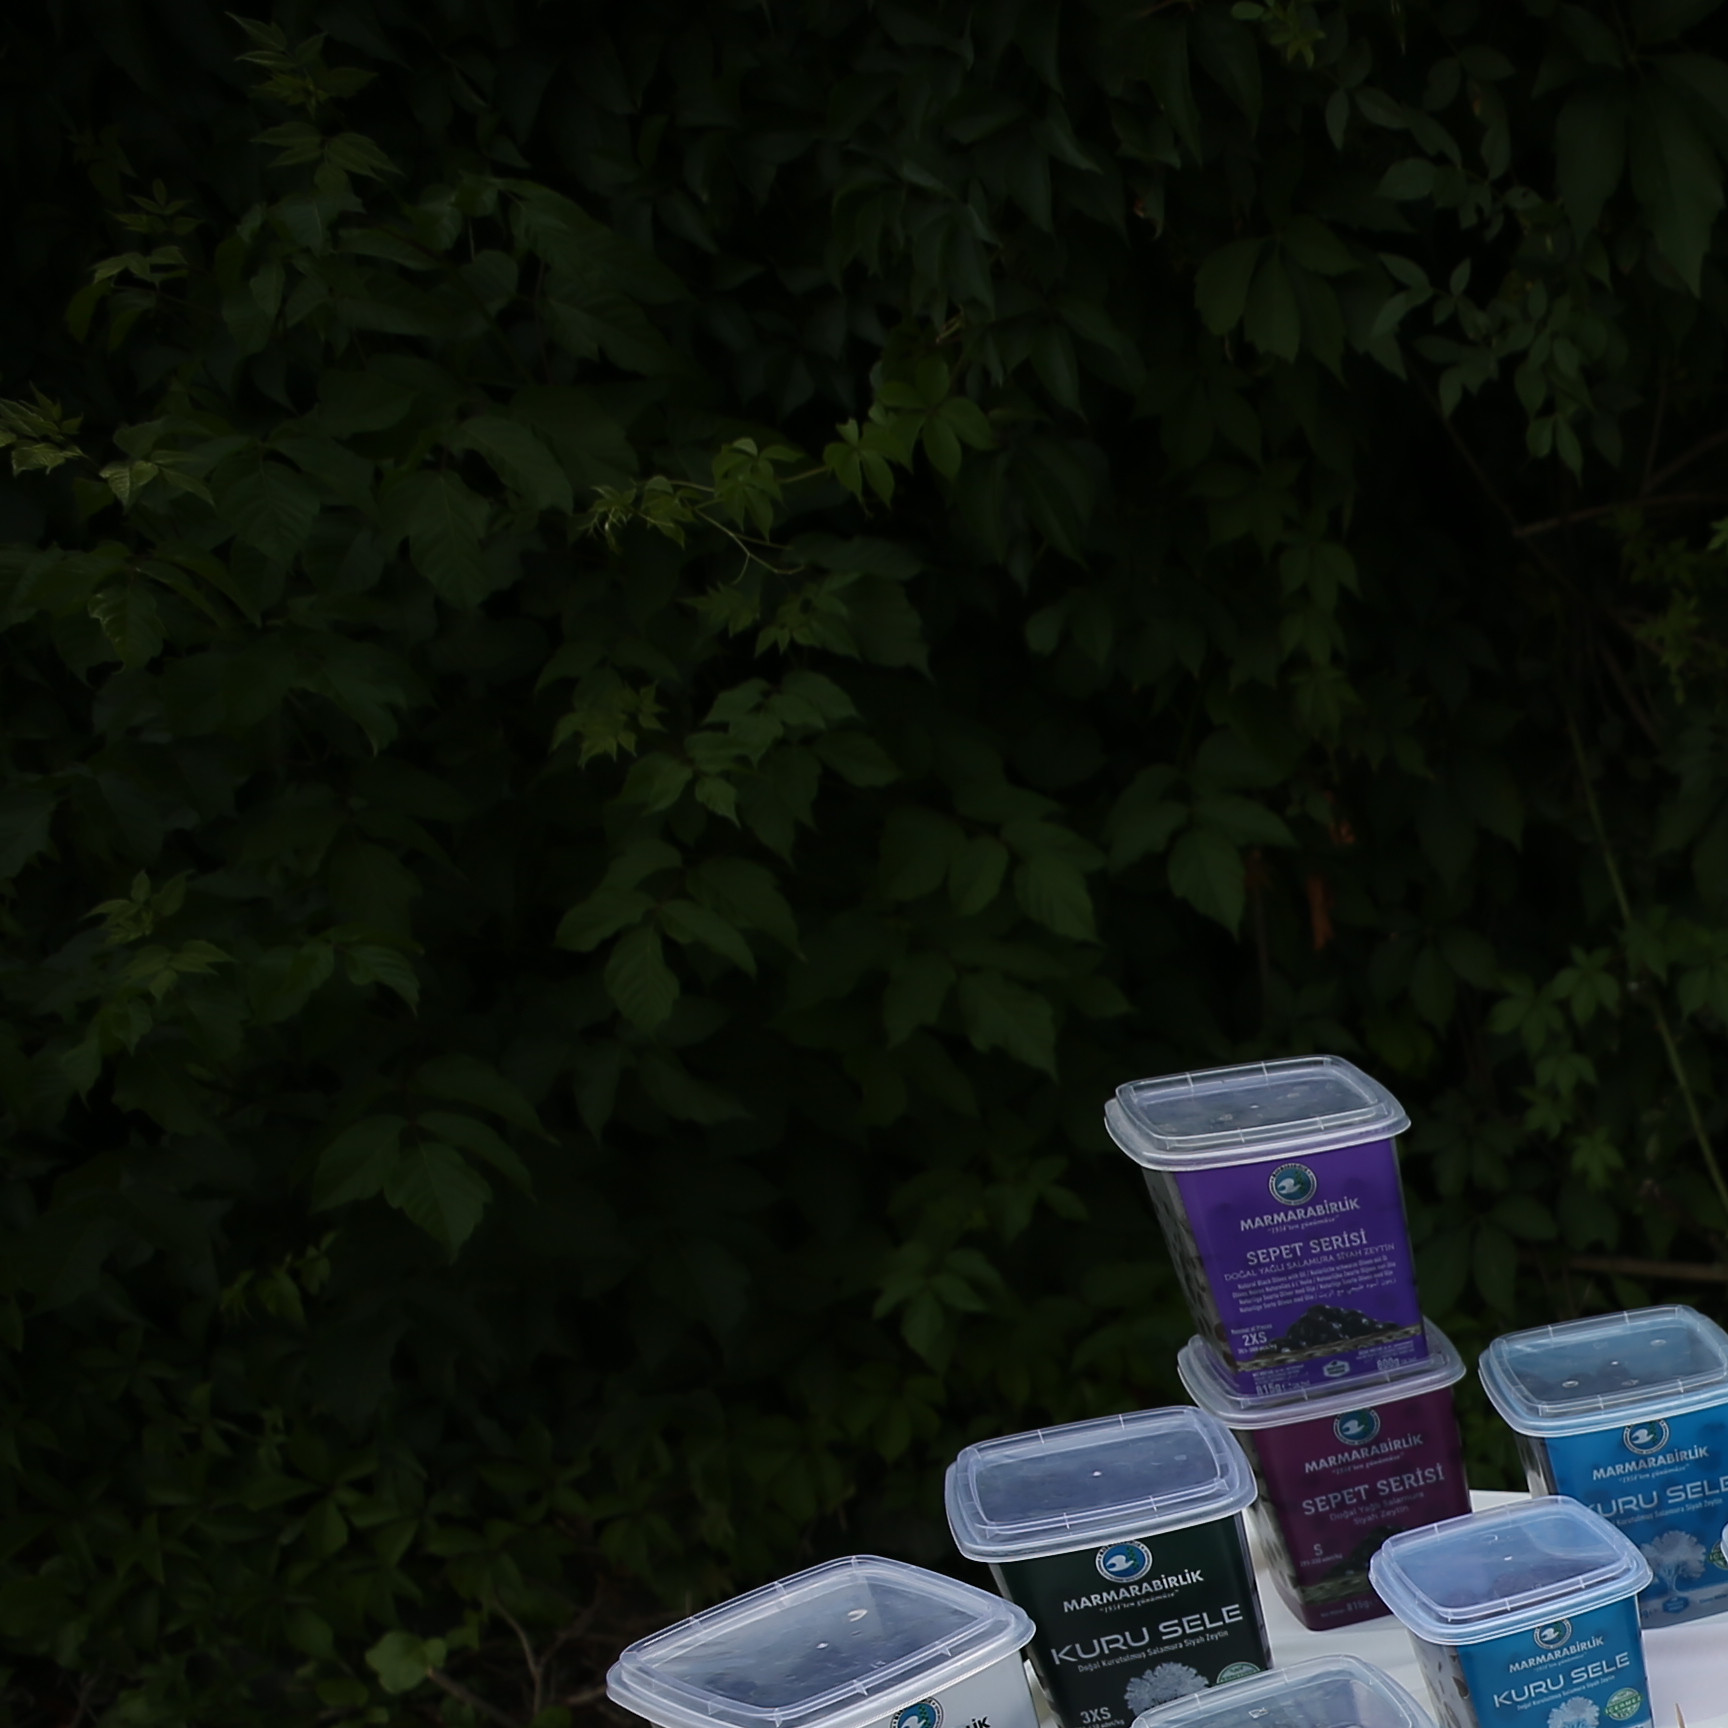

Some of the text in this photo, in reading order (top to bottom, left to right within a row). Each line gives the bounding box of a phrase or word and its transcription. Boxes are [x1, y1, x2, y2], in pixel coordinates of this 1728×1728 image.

[1241, 1196, 1360, 1231] MARMARABİRLİK
[1225, 1243, 1395, 1281] DOĞAL YAĞLI SALAMURA SİYAH ZEYTİN
[1247, 1229, 1367, 1265] SEPET SERİSİ
[1242, 1332, 1267, 1346] 2XS
[1305, 1434, 1423, 1473] MARMARABİRLİK
[1593, 1445, 1709, 1480] MARMARABİRLİK
[1303, 1463, 1445, 1515] SEPET SERİSİ
[1587, 1492, 1658, 1518] URU
[1314, 1544, 1322, 1556] S
[1063, 1570, 1204, 1613] MARMARABİRLİK
[1051, 1604, 1243, 1665] KURU SELE
[1078, 1630, 1228, 1673] Doğal Kurutulmuş Salamura Siyah Zeytin
[1509, 1636, 1604, 1673] MARMARABİRLİK
[1494, 1675, 1564, 1708] KURU
[1571, 1652, 1630, 1684] SELE
[1080, 1707, 1111, 1724] 3XS
